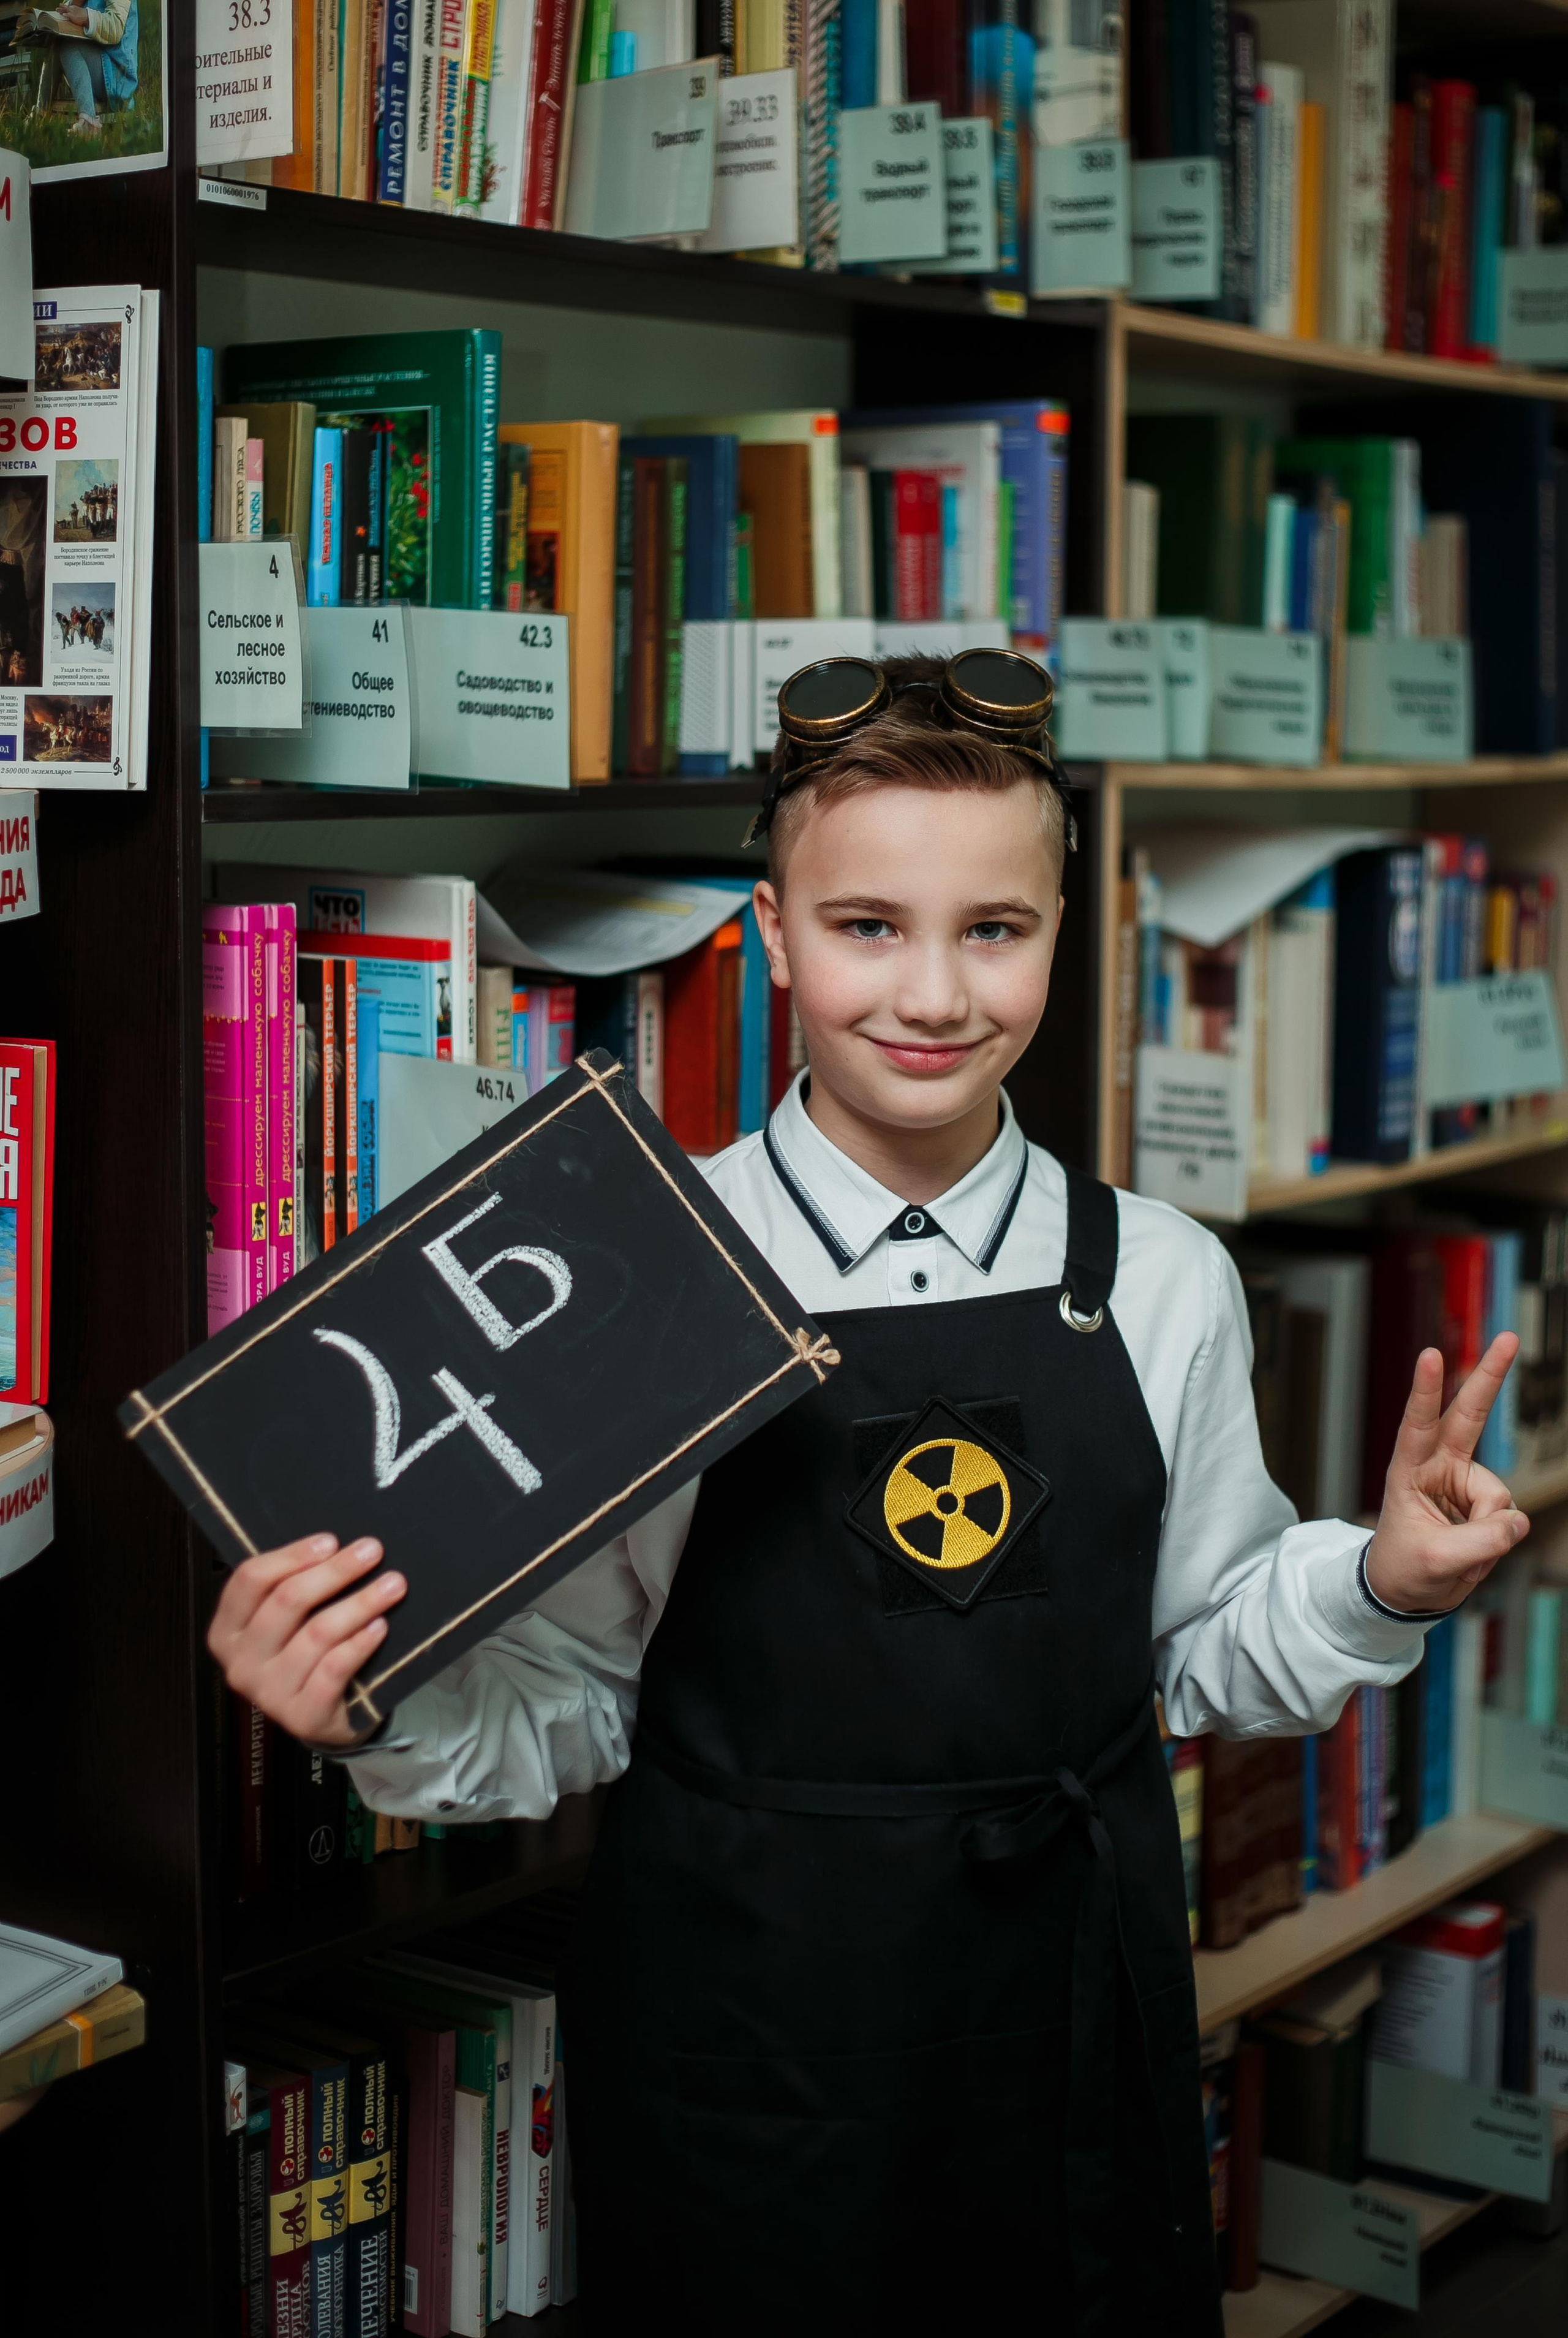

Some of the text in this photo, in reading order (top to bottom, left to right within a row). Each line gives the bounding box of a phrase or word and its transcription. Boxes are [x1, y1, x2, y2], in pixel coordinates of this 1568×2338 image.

[228, 0, 271, 32] 38.3
[195, 44, 272, 70] оительные
[392, 60, 406, 74] В
[196, 77, 272, 104] териалы и
[417, 0, 437, 153] СПРАВОЧНИК ДОМА
[209, 107, 272, 131] изделия.
[440, 59, 459, 191] СПРАВОЧНИК
[387, 83, 405, 194] РЕМОНТ
[206, 183, 260, 200] 0101060001976
[0, 417, 77, 452] ЗОВ
[0, 460, 37, 470] ЧЕСТВА
[269, 554, 279, 579] 4
[208, 610, 284, 630] Сельское и
[372, 619, 389, 643] 41
[520, 624, 552, 649] 42.3
[236, 641, 285, 657] лесное
[215, 667, 286, 686] хозяйство
[352, 672, 394, 693] Общее
[457, 670, 554, 694] Садоводство и
[458, 700, 554, 721] овощеводство
[0, 867, 26, 914] ДА
[314, 895, 360, 917] ЧТО
[252, 932, 265, 1187] дрессируем маленькую собачку
[281, 929, 294, 1182] дрессируем маленькую собачку
[324, 983, 334, 1157] ЙОРКШИРСКИЙ ТЕРЬЕР
[347, 983, 356, 1157] ЙОРКШИРСКИЙ ТЕРЬЕР
[477, 1076, 514, 1103] 46.74
[282, 1250, 291, 1273] ВУД
[320, 2082, 333, 2143] ПОЛНЫЙ
[362, 2065, 375, 2125] ПОЛНЫЙ
[376, 2059, 386, 2151] справочник
[281, 2094, 294, 2155] ПОЛНЫЙ
[296, 2088, 307, 2180] справочник
[335, 2077, 346, 2169] справочник
[249, 2150, 263, 2214] ЗДОРОВЬЯ
[496, 2129, 510, 2245] НЕВРОЛОГИЯ
[537, 2165, 549, 2232] СЕРДЦЕ
[250, 2217, 264, 2280] РЕЦЕПТЫ
[290, 2280, 303, 2338] РДЦА
